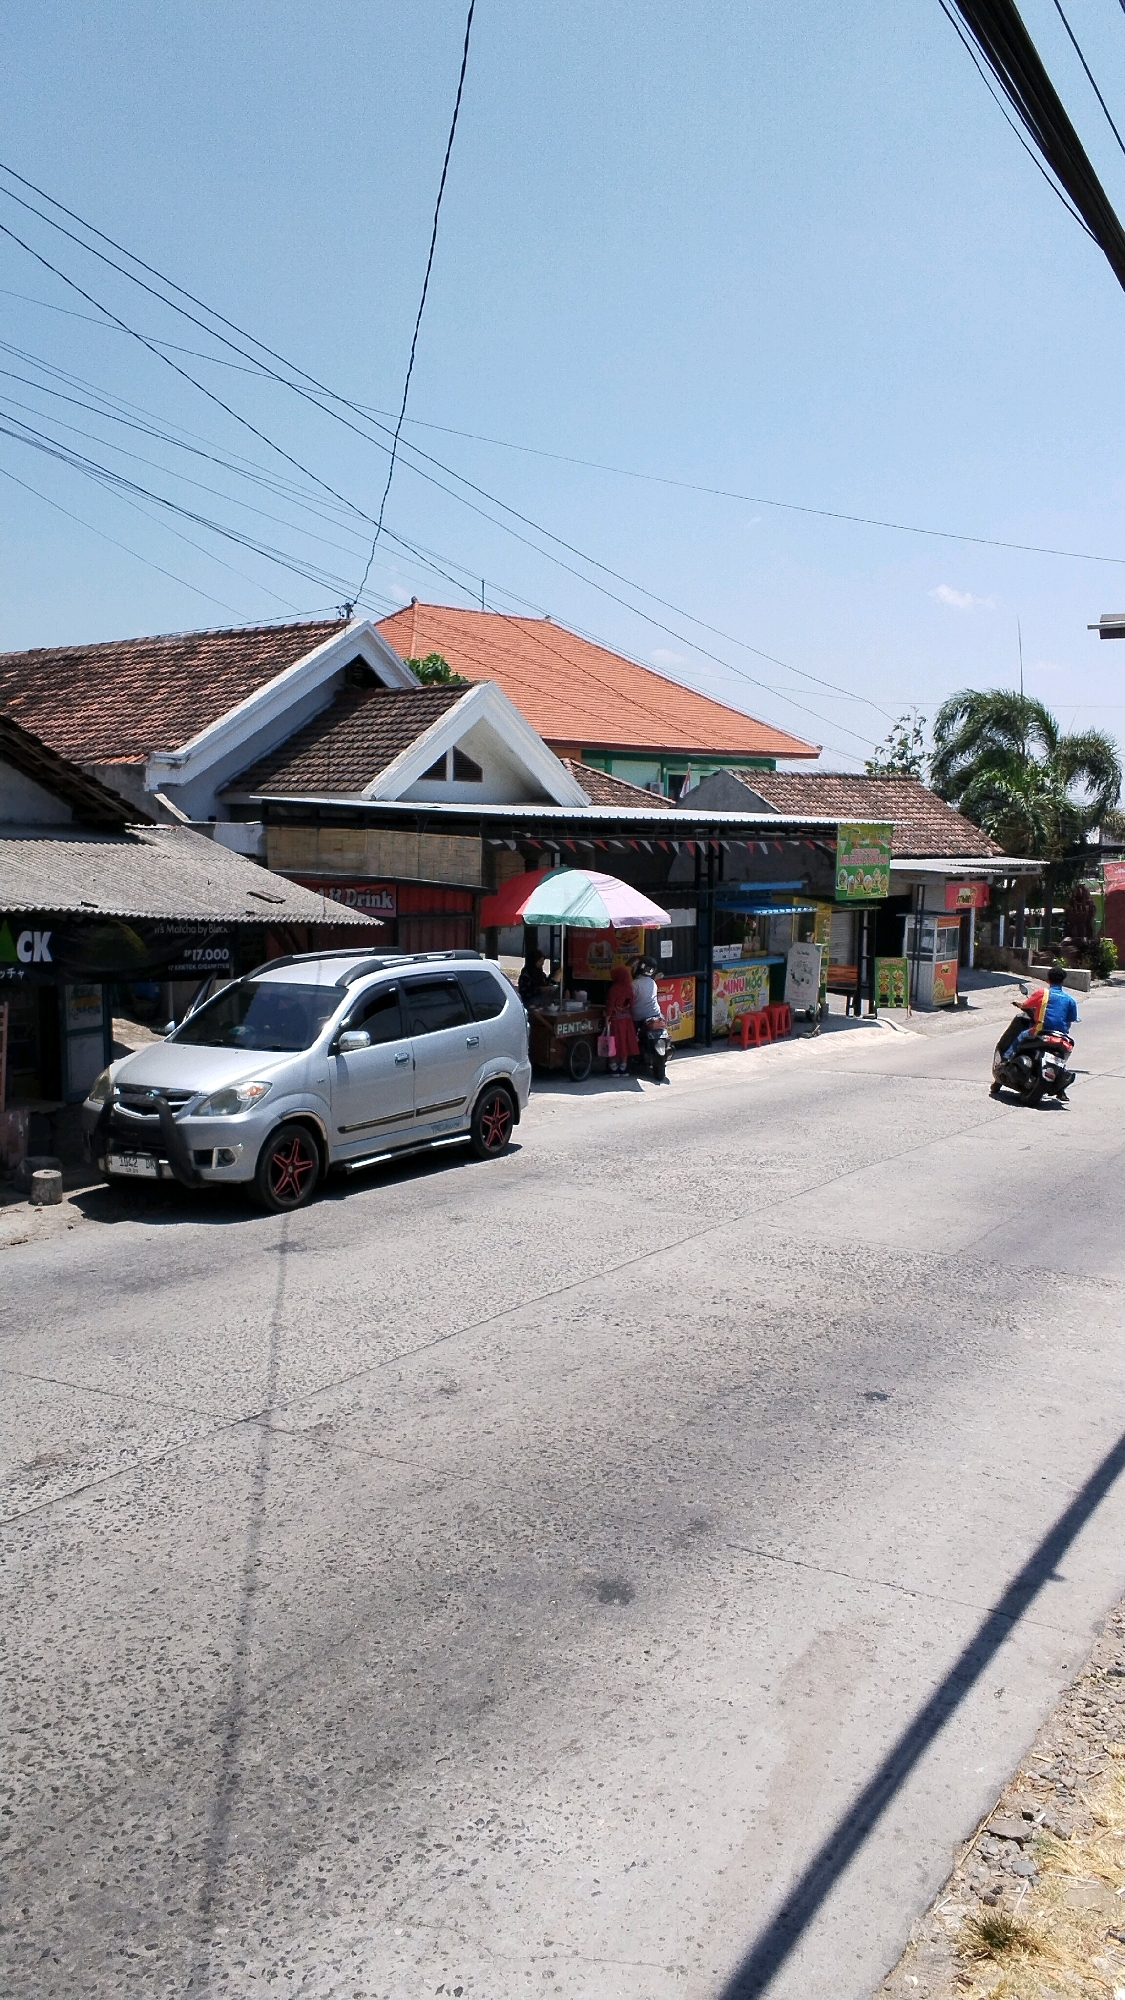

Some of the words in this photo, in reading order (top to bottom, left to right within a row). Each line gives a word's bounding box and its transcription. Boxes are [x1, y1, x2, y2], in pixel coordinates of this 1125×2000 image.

[345, 888, 394, 909] Drink
[166, 922, 197, 934] Matcha
[197, 922, 208, 937] by
